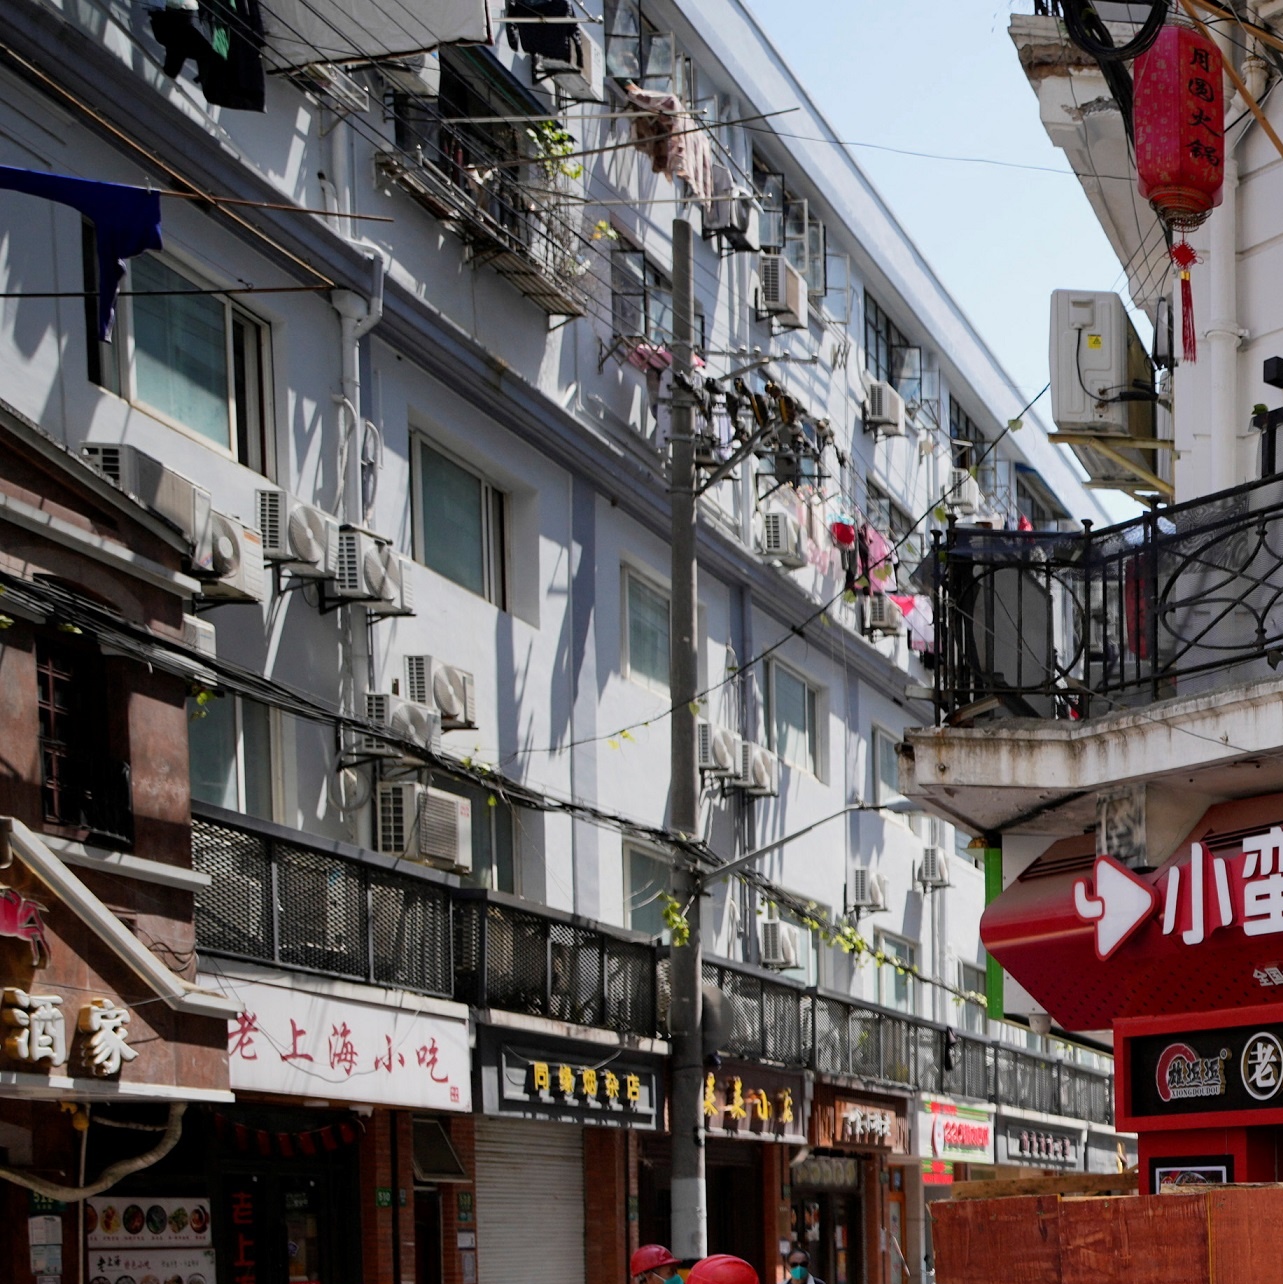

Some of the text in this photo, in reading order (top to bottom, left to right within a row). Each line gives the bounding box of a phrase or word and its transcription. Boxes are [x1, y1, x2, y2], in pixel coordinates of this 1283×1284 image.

[4, 987, 139, 1075] 酒家
[229, 1012, 449, 1084] 老上海小吃
[1172, 1086, 1220, 1098] XIONGDOUDOU
